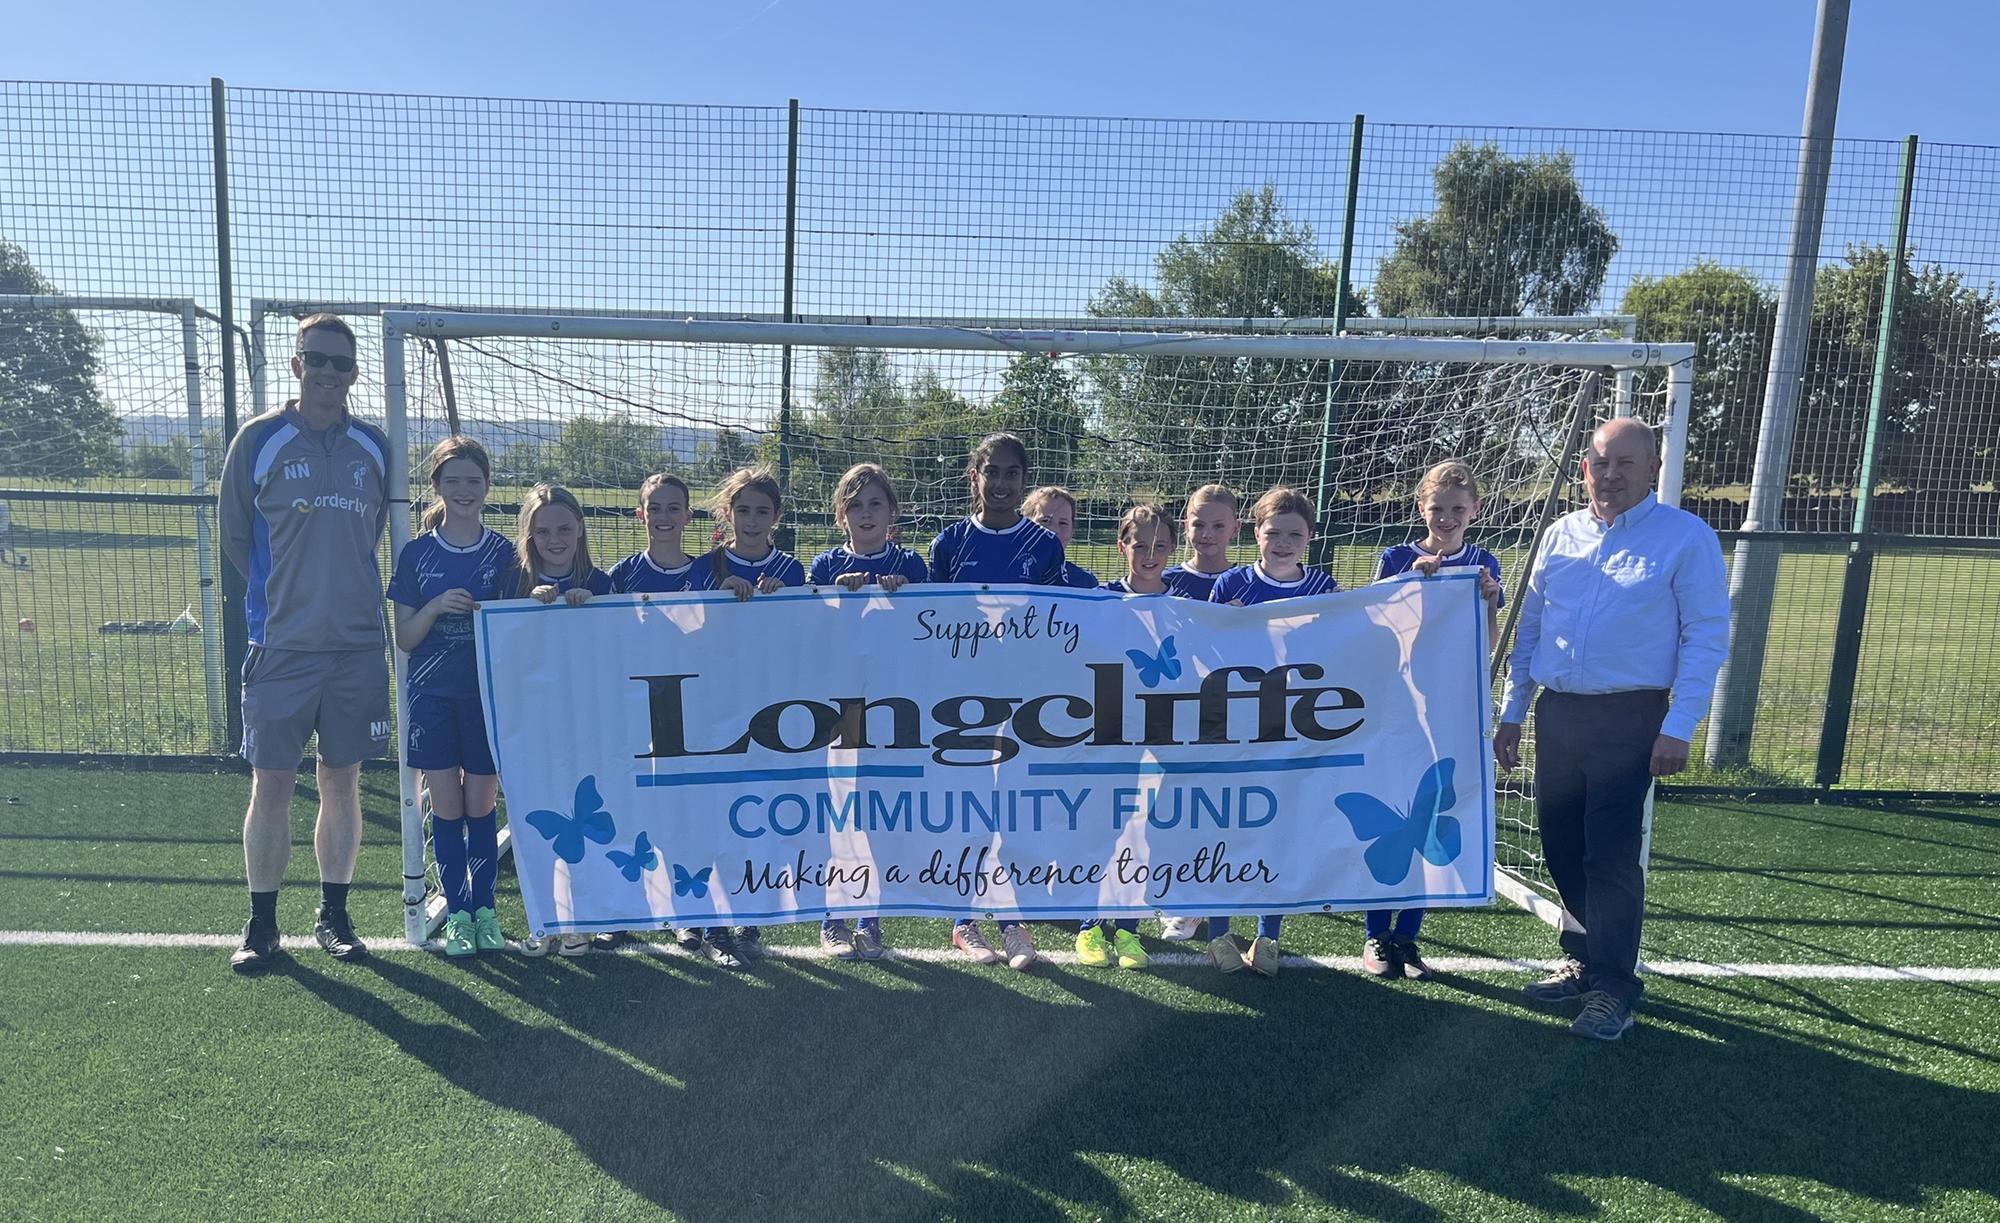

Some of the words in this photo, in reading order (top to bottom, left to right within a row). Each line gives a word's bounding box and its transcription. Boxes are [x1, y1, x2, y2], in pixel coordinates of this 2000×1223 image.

[284, 463, 311, 480] NN
[314, 493, 367, 517] orderly
[913, 605, 1040, 659] Support
[1047, 603, 1079, 654] by
[370, 720, 390, 737] NN
[629, 662, 1366, 767] Longcliffe
[728, 787, 1092, 839] COMMUNITY
[1112, 785, 1278, 830] FUND
[731, 849, 871, 900] Making
[885, 863, 910, 884] a
[918, 846, 1108, 897] difference
[1116, 841, 1280, 898] together
